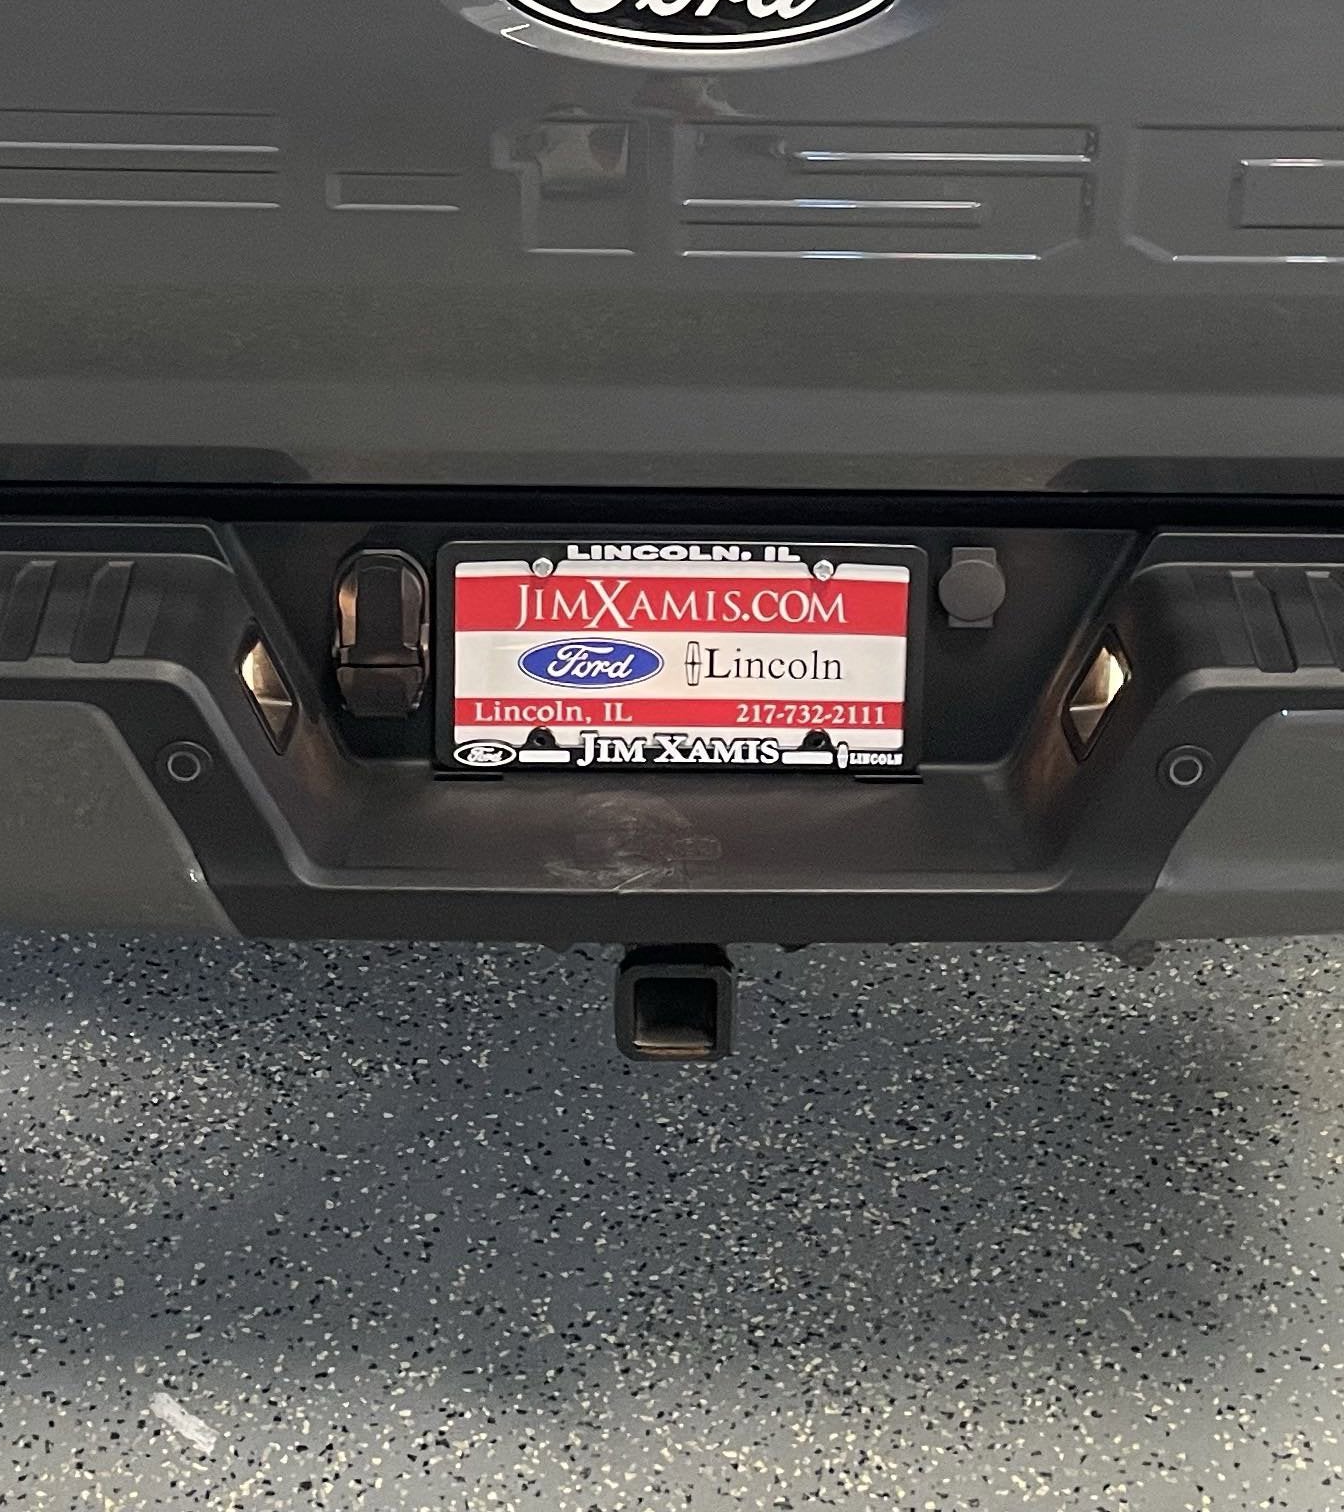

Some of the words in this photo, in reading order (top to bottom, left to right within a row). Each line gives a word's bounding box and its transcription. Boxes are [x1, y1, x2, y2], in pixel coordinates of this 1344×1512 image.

[763, 546, 801, 562] IL
[546, 644, 635, 679] Ford
[704, 647, 844, 681] Lincoln
[474, 700, 593, 725] Lincoln,
[603, 702, 633, 723] IL
[735, 703, 886, 726] 217-732-2111
[576, 733, 648, 767] JIM
[653, 735, 780, 764] XAMIS
